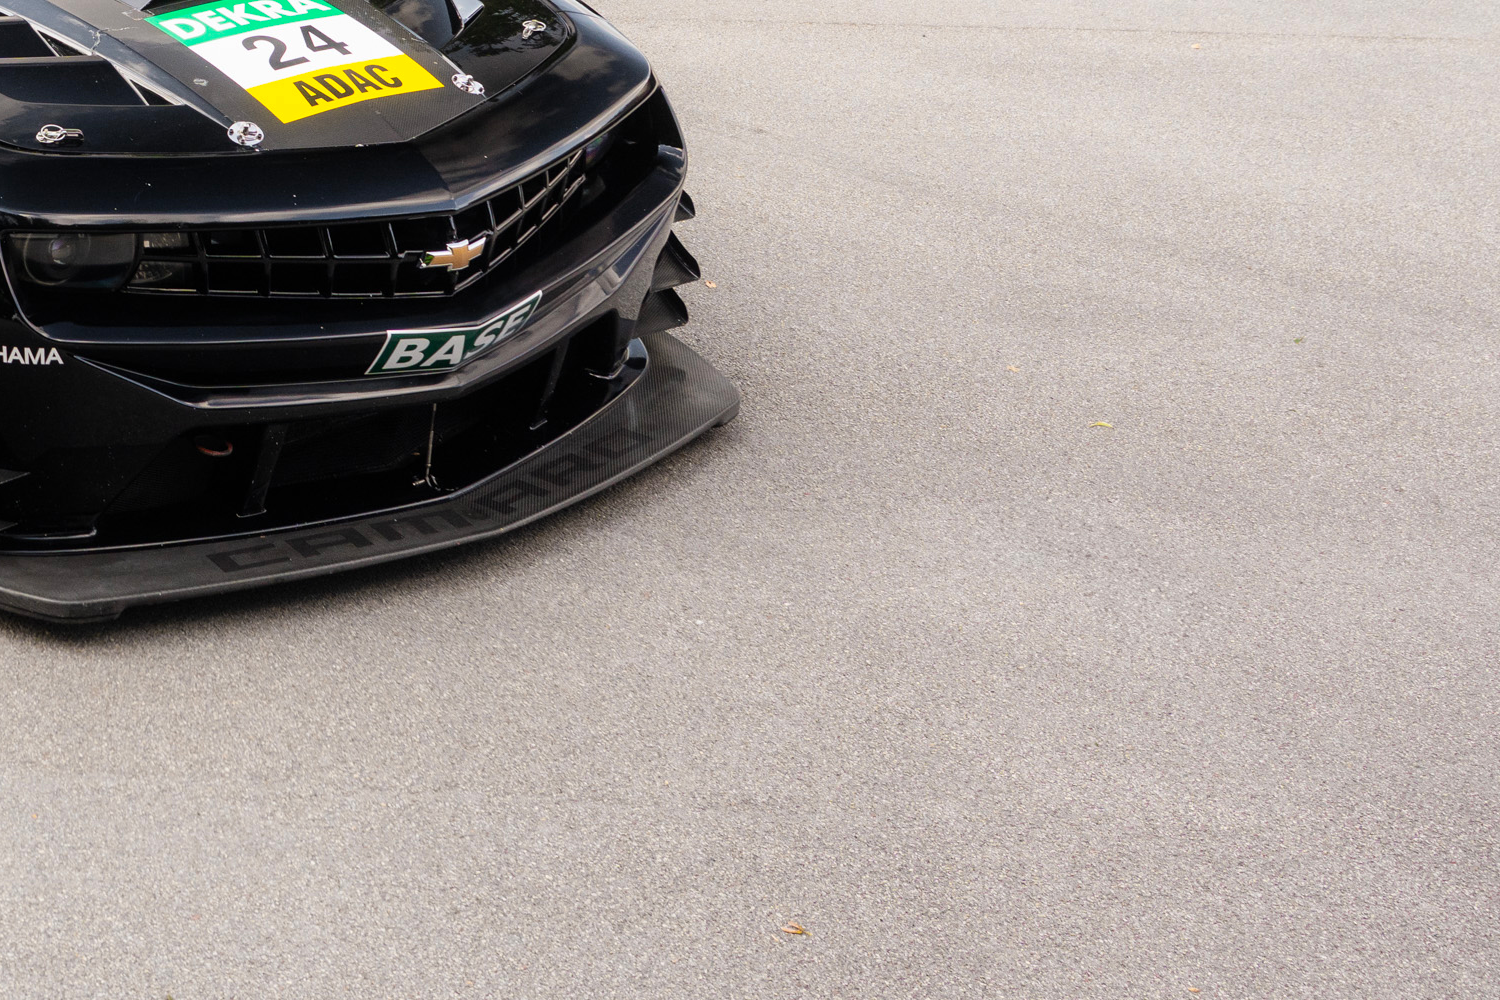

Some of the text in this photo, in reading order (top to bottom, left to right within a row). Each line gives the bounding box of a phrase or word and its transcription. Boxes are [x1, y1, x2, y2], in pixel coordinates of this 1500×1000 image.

[241, 24, 352, 70] 24
[292, 64, 403, 107] ADAC
[382, 304, 531, 370] BASE
